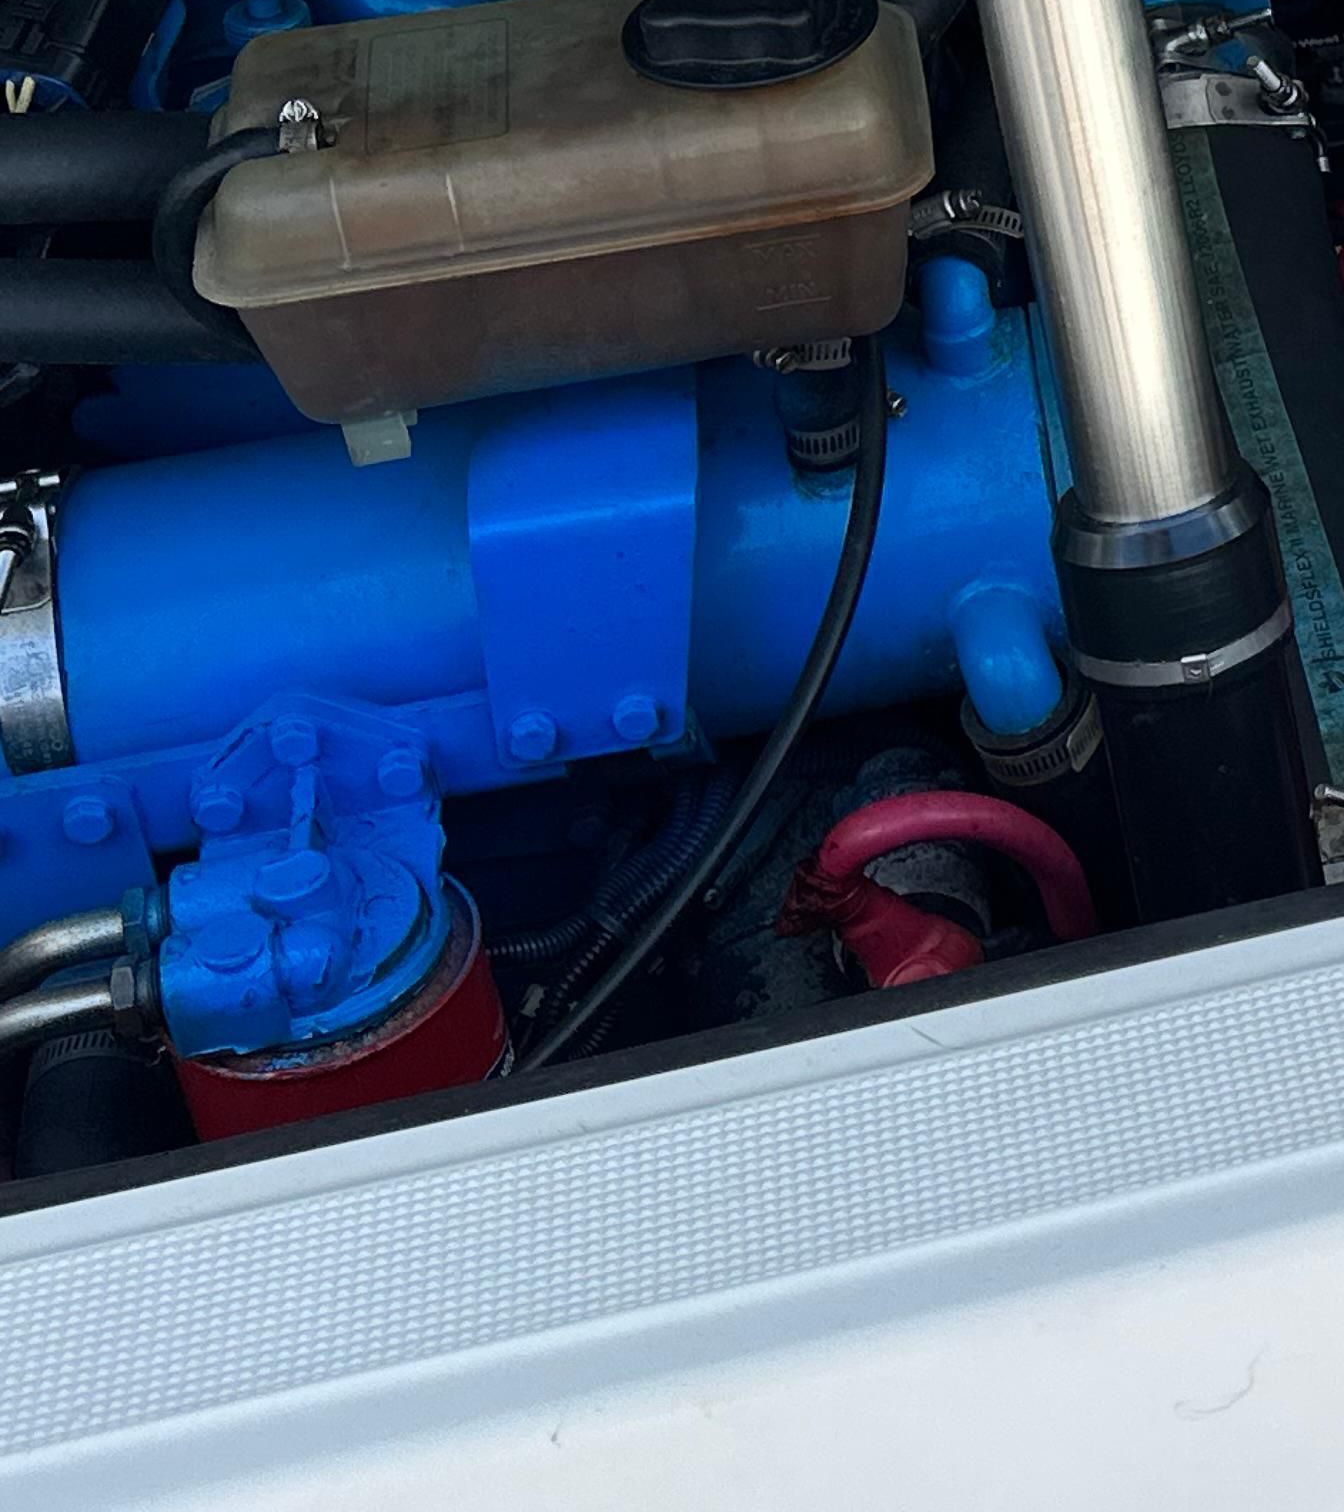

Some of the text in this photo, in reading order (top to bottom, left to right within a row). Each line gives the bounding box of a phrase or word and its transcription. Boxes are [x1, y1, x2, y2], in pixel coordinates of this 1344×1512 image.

[1204, 261, 1226, 297] SAE
[1257, 436, 1280, 470] WET
[1268, 472, 1301, 536] MARINE
[1290, 550, 1338, 659] SHIELDSFLEX
